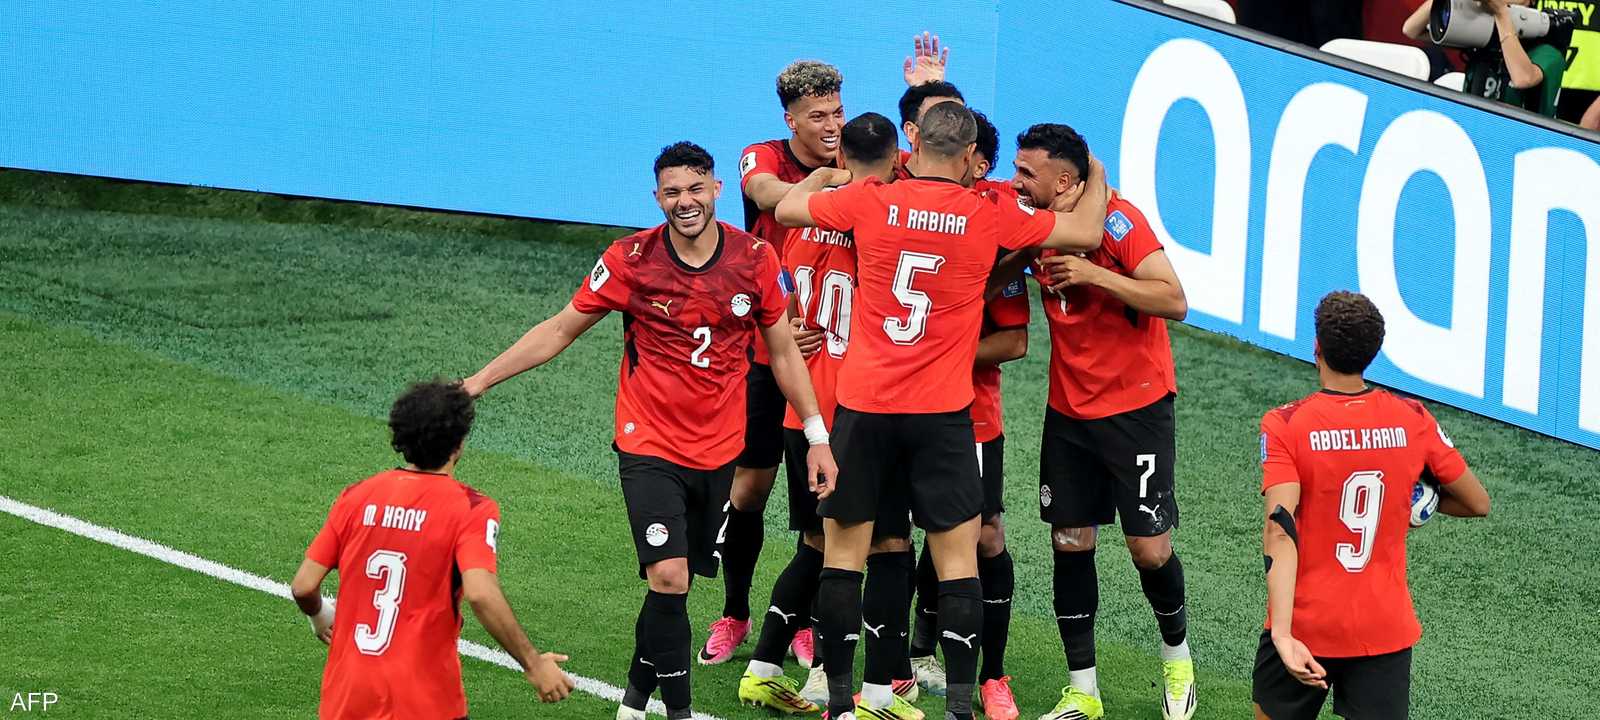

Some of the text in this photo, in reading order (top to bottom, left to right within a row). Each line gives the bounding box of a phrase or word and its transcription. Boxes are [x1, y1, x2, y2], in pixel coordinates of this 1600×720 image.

[887, 204, 967, 235] R. RABIAA
[793, 265, 854, 359] 10
[883, 250, 946, 346] 5
[690, 326, 712, 368] 2
[1309, 427, 1407, 451] ABDELKARIM
[1136, 454, 1156, 498] 7
[363, 504, 427, 531] M. HANY
[1336, 470, 1385, 572] 9
[354, 549, 408, 656] 3
